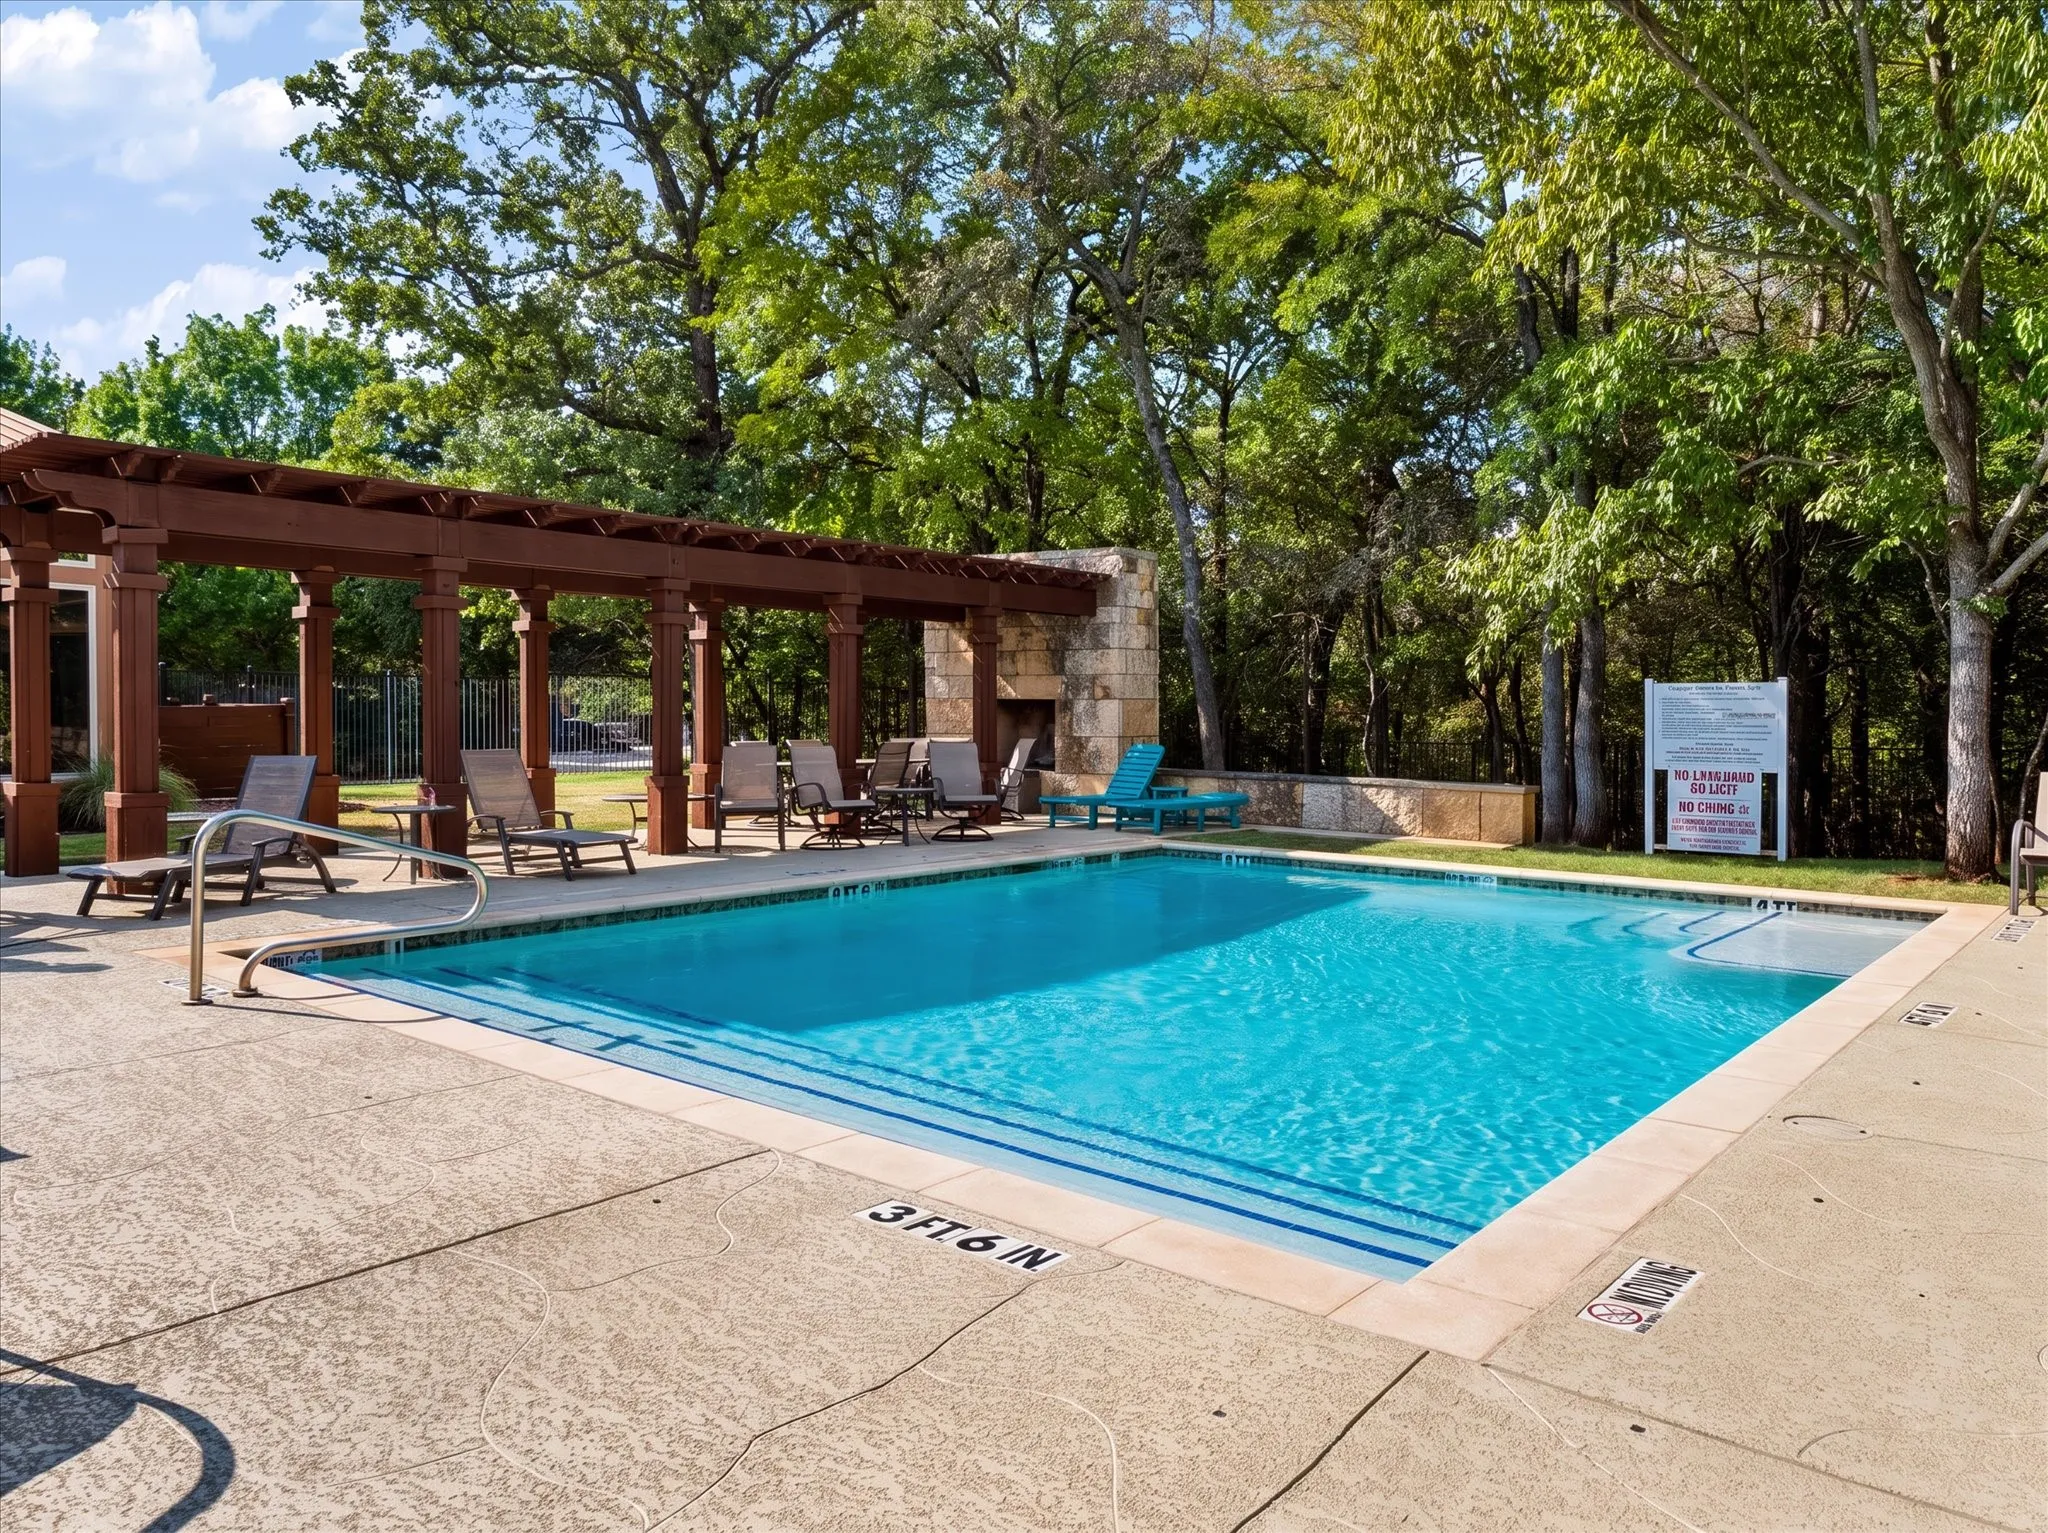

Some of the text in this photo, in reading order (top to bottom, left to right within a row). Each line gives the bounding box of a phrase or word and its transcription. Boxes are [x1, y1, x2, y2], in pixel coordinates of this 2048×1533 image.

[1674, 770, 1689, 781] NO
[1678, 801, 1694, 813] NO
[868, 1205, 918, 1223] 3
[956, 1235, 1008, 1252] 6
